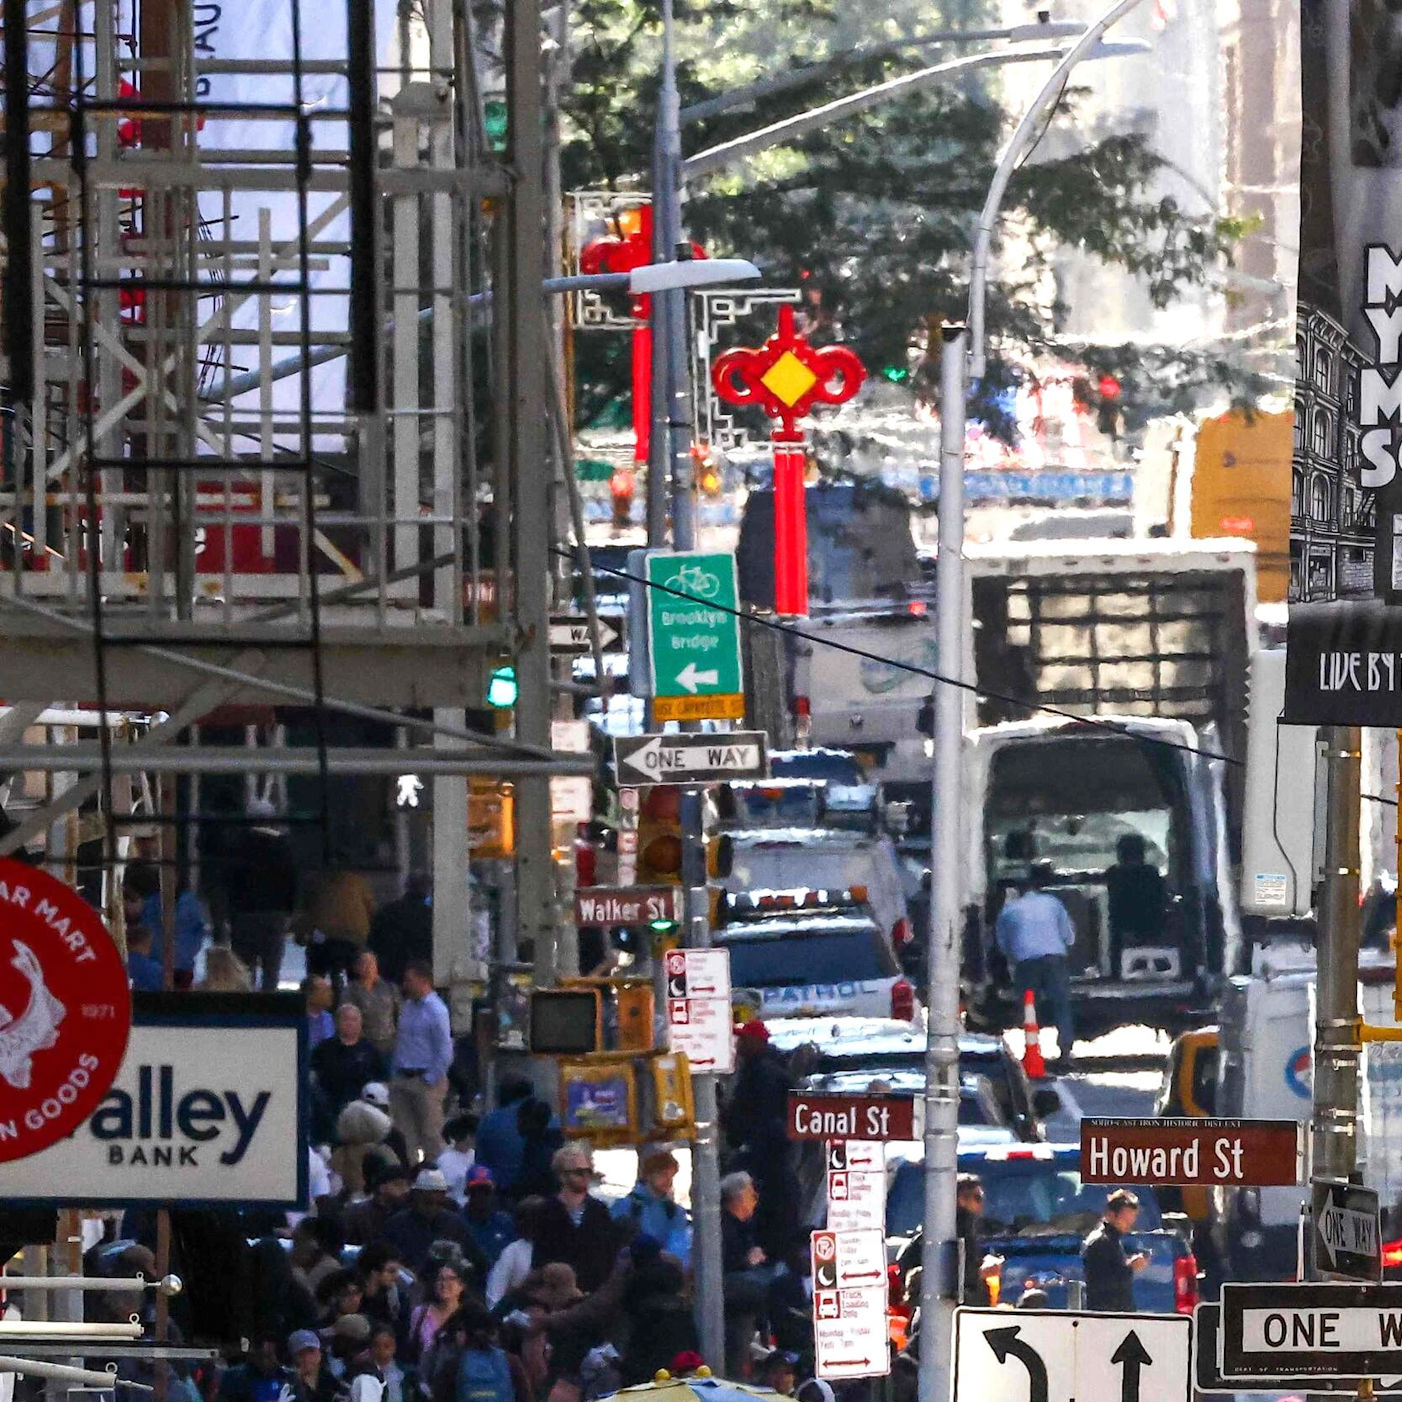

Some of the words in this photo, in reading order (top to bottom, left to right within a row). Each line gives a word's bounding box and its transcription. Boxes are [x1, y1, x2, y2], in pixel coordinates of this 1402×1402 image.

[1319, 652, 1362, 692] LIVE
[1368, 652, 1396, 692] BY
[646, 750, 685, 769] ONE
[708, 748, 749, 767] WAY
[580, 899, 640, 922] Walker
[647, 896, 666, 921] St
[34, 898, 97, 963] MART
[24, 1052, 100, 1131] GOODS
[89, 1064, 272, 1166] alley
[795, 1104, 857, 1135] Canal
[866, 1106, 891, 1136] St
[108, 1145, 200, 1167] BANK
[1090, 1136, 1200, 1179] Howard
[1213, 1137, 1245, 1179] St
[1325, 1209, 1346, 1248] ONE
[1352, 1215, 1372, 1253] WAY
[1263, 1312, 1340, 1347] ONE
